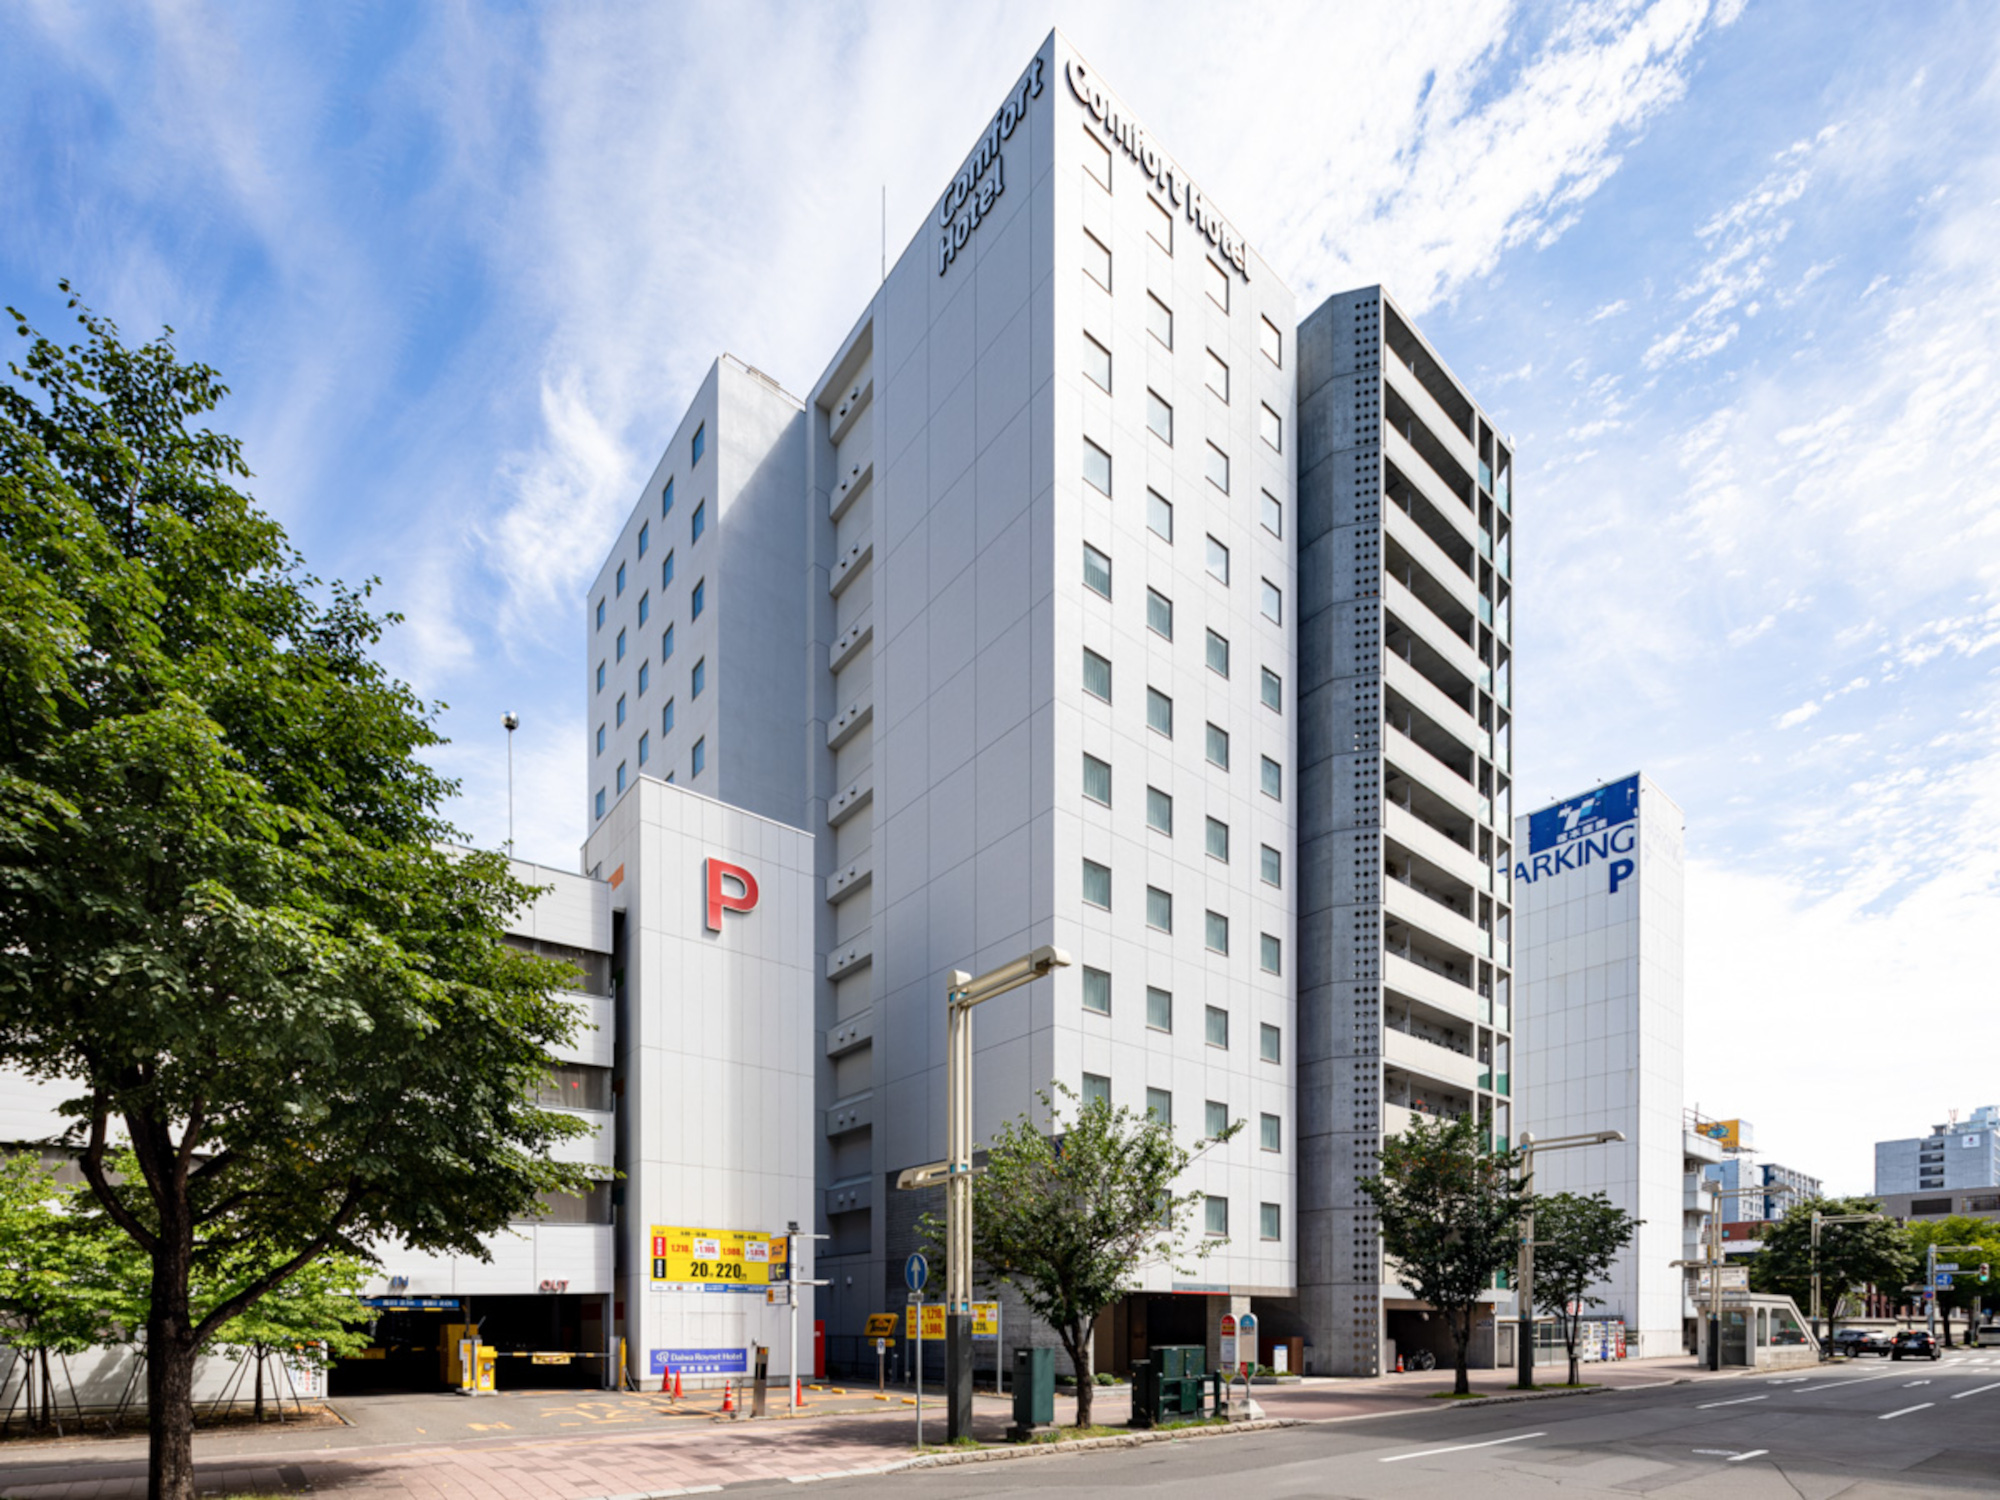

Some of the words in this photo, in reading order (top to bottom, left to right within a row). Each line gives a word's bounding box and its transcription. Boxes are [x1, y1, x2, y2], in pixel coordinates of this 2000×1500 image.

[939, 56, 1043, 228] Comfort
[1064, 60, 1181, 207] Comfort
[1185, 182, 1250, 284] Hotel
[939, 154, 1005, 277] Hotel
[1497, 823, 1636, 884] ARKING
[1608, 858, 1635, 894] P
[702, 856, 759, 934] P
[391, 1276, 409, 1288] IN
[540, 1280, 569, 1291] OUT
[671, 1353, 694, 1362] Daiwa
[694, 1352, 722, 1363] Roynet
[722, 1352, 743, 1361] Hotel
